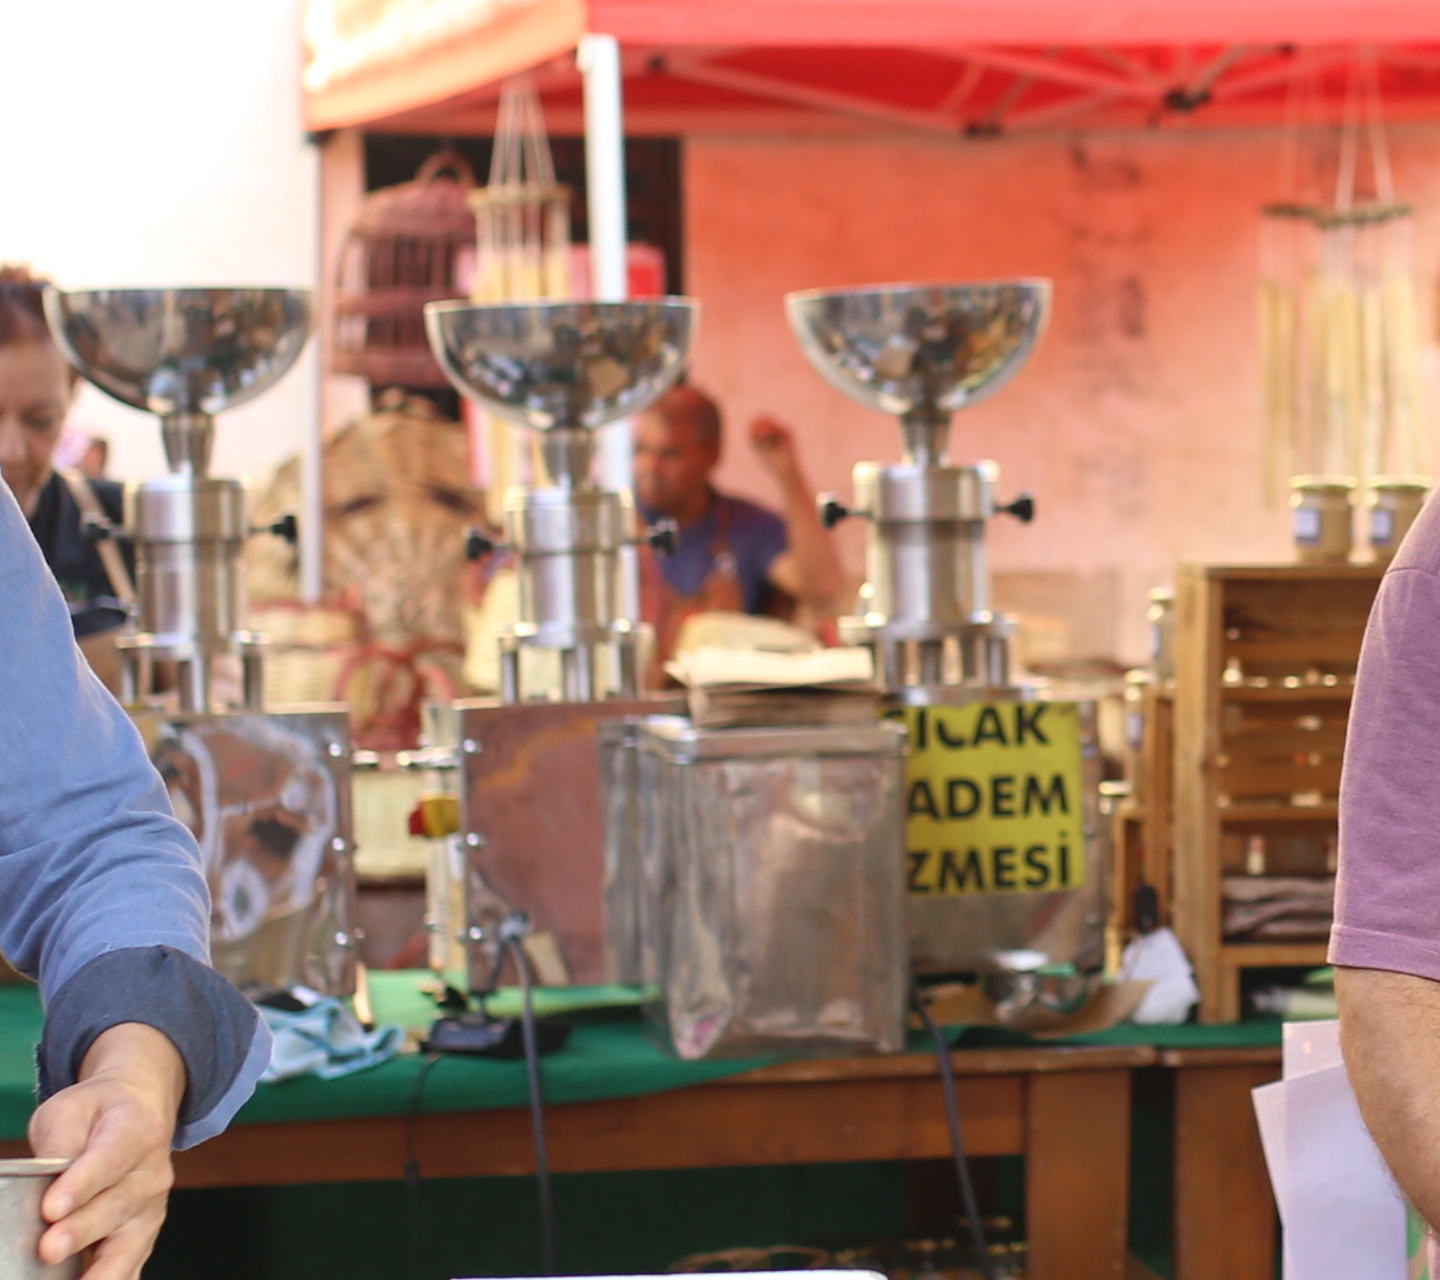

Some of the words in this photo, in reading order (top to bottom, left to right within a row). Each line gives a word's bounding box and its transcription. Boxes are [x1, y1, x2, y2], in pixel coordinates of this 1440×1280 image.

[881, 703, 1050, 750] ICAK
[907, 775, 1070, 820] ADEM
[906, 831, 1071, 892] ZMESİ
